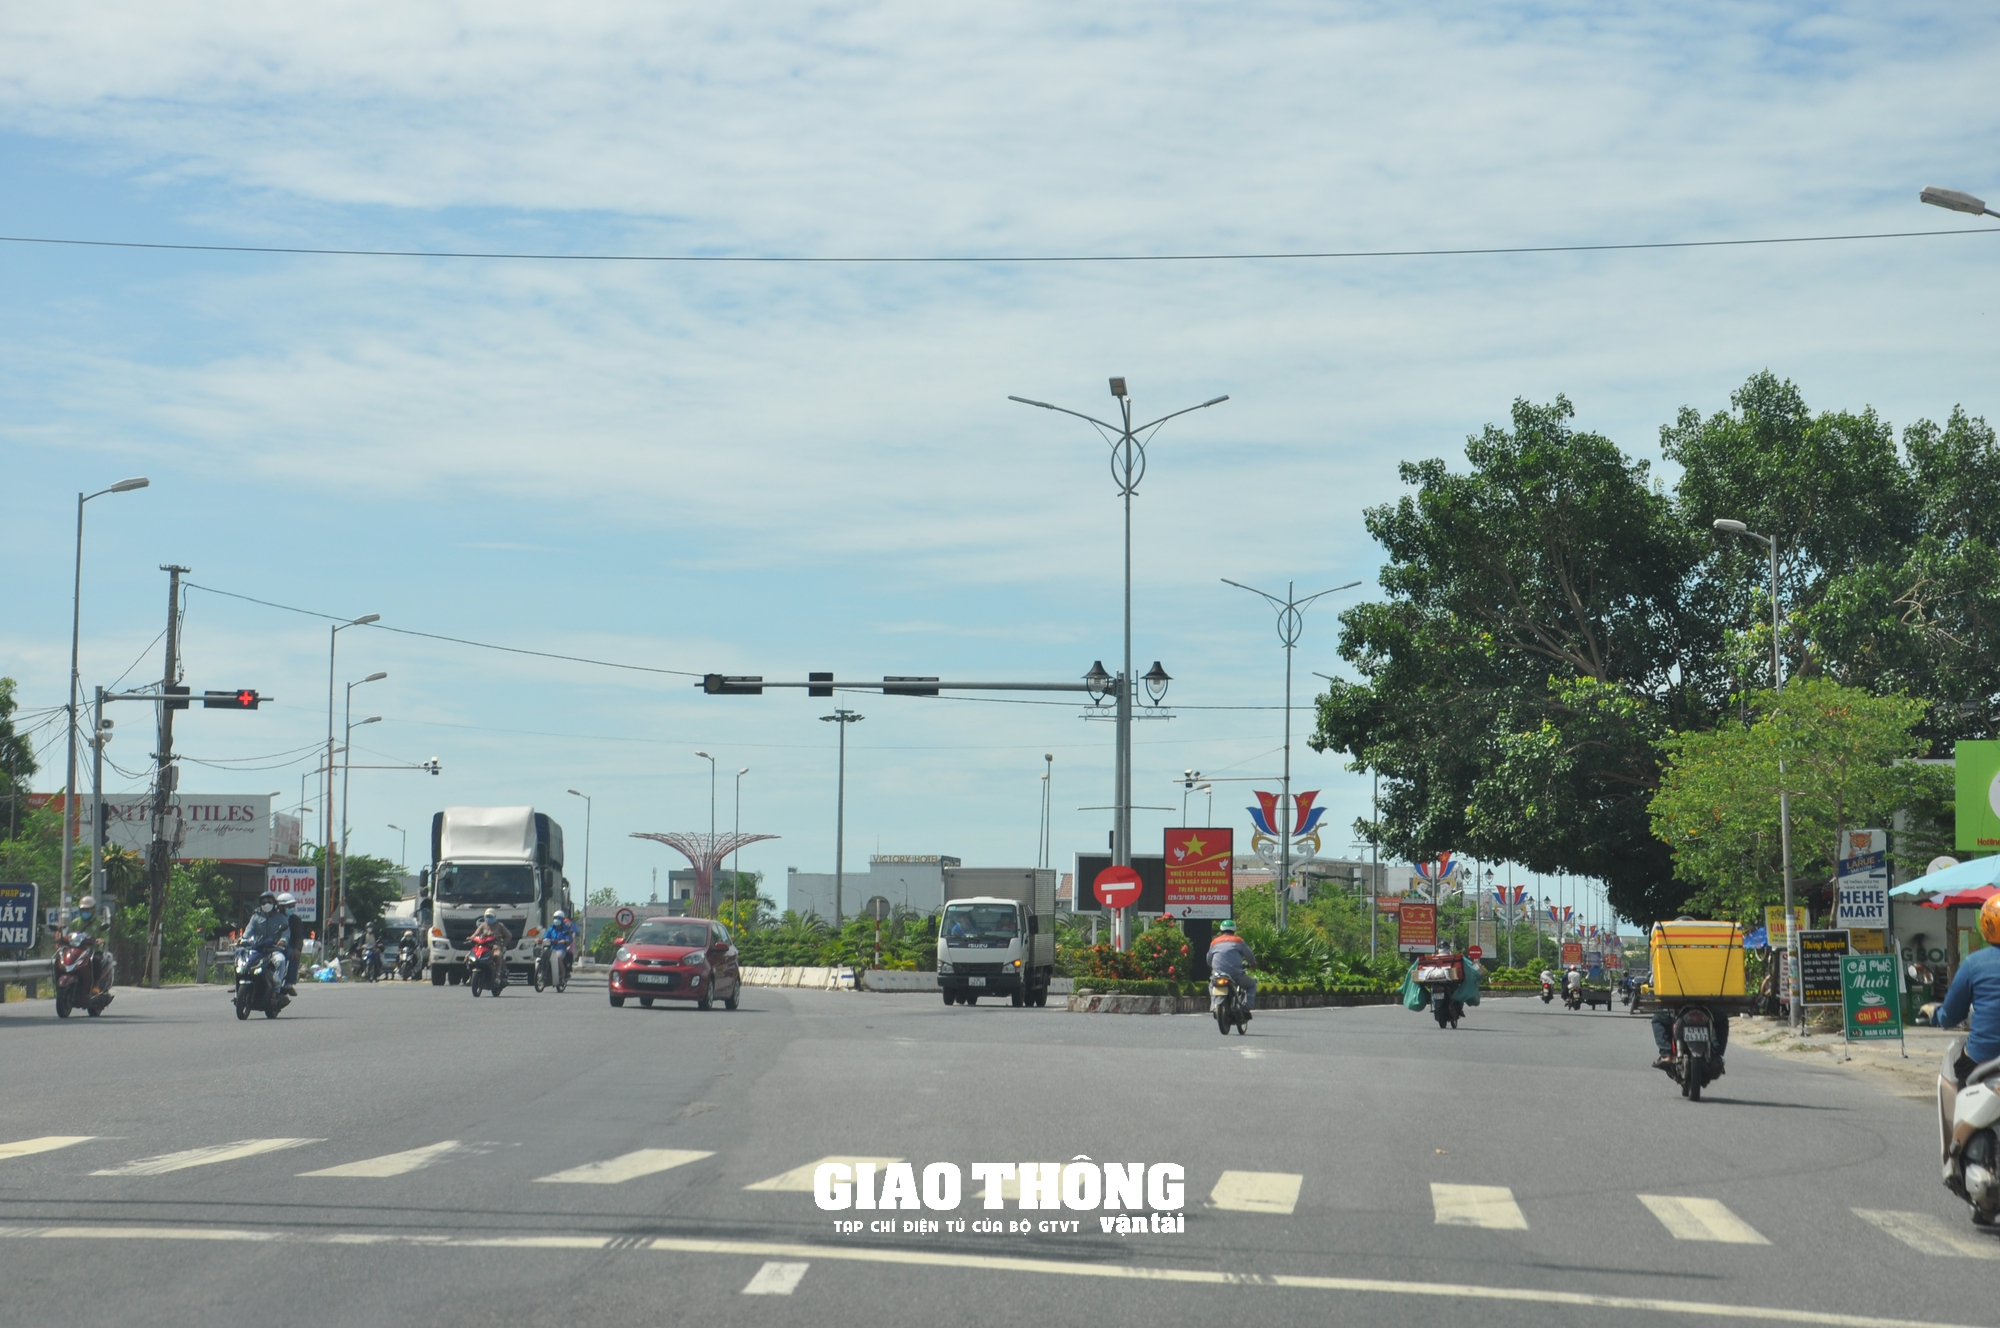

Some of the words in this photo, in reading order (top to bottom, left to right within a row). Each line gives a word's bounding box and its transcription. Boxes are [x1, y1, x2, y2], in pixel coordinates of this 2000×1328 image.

[188, 805, 254, 821] TILES
[872, 855, 911, 863] VICTORY
[914, 855, 938, 863] HOTEL
[1846, 856, 1875, 870] LARUE
[1840, 891, 1884, 904] HEHE
[1840, 905, 1884, 918] MART
